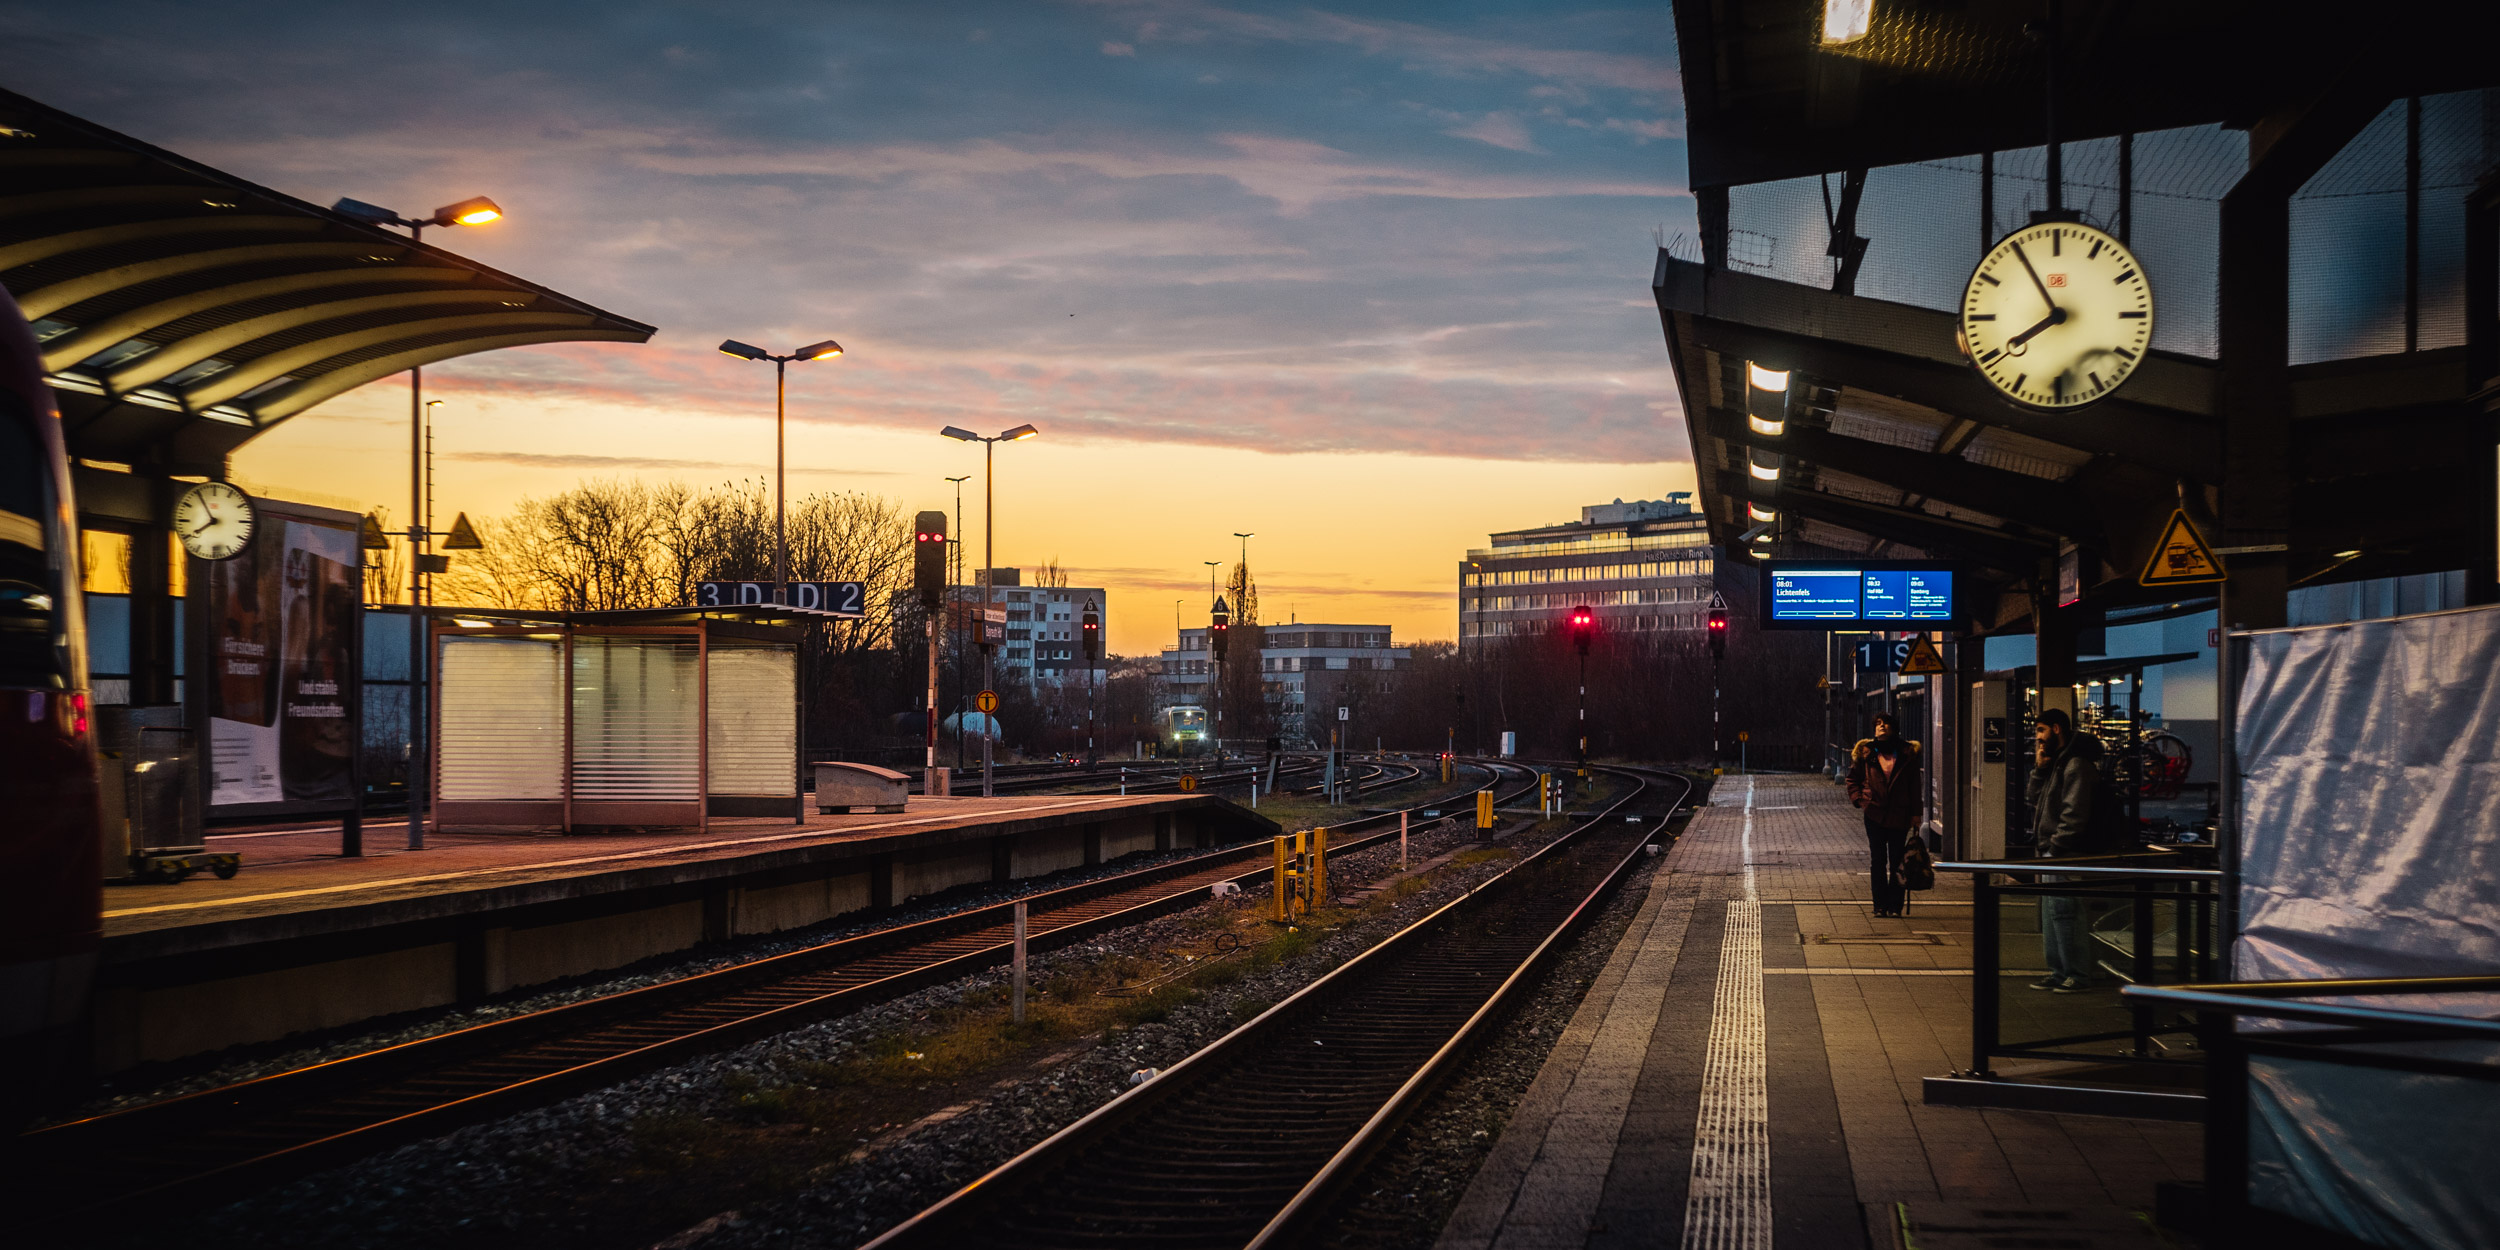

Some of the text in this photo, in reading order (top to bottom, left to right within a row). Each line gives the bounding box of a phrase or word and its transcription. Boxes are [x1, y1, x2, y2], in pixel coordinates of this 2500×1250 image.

[2050, 276, 2063, 286] DB
[1644, 549, 1704, 561] Haus Deutscher Ring
[702, 583, 762, 606] 3 D
[798, 583, 860, 611] D 2
[1776, 588, 1811, 596] Lichtenfels
[1087, 600, 1094, 611] 6
[1217, 600, 1224, 611] 6
[1715, 597, 1720, 608] 6
[238, 638, 265, 656] sichere
[1860, 643, 1870, 667] 1
[299, 680, 338, 695] Und stabile
[1341, 708, 1347, 719] 7
